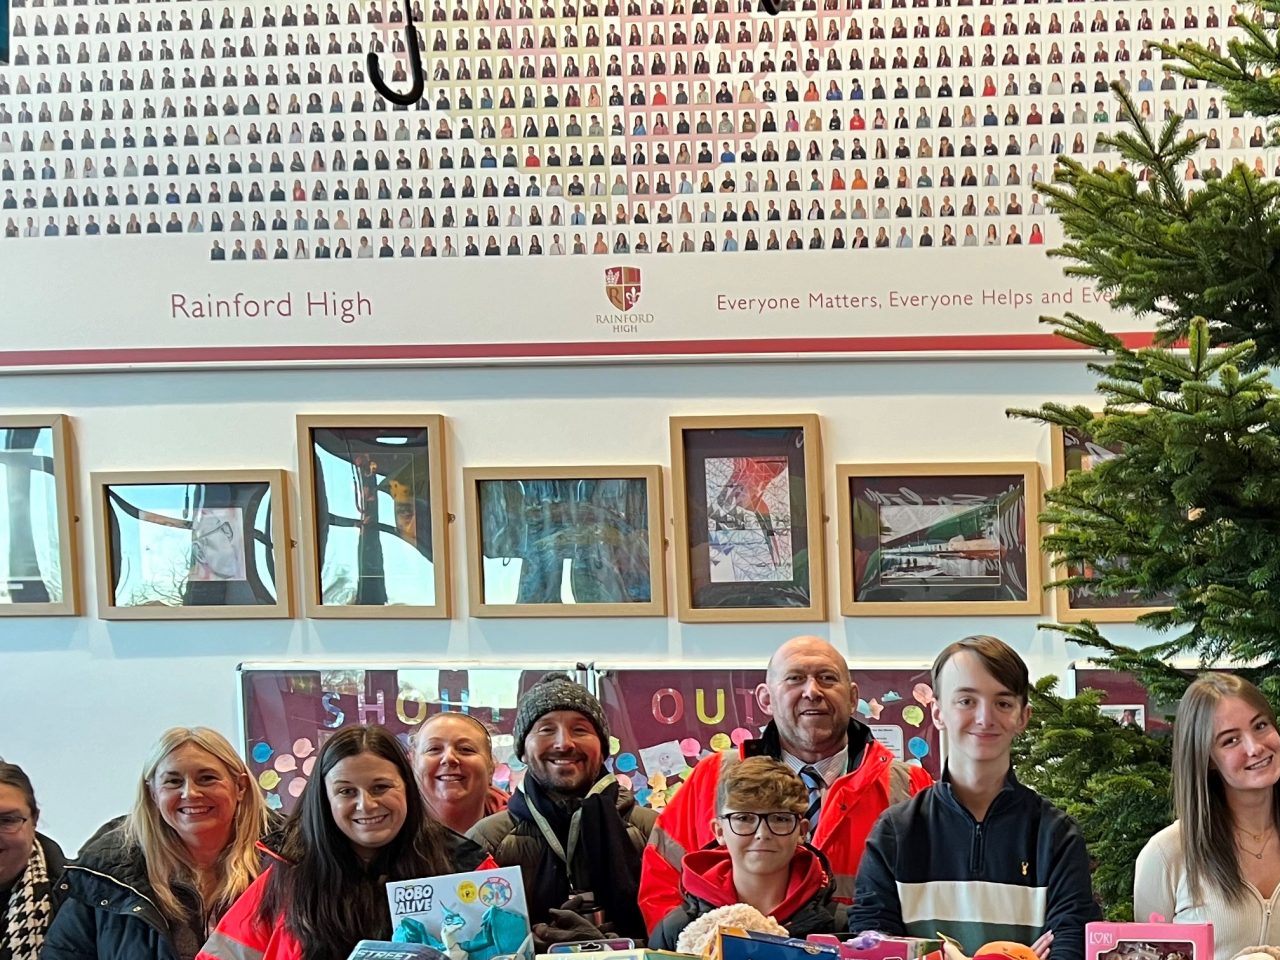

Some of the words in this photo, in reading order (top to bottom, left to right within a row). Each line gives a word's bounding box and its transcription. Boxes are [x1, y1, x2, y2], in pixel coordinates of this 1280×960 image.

[171, 292, 292, 318] Rainford
[307, 291, 372, 324] High
[717, 294, 801, 315] Everyone
[808, 291, 882, 309] Matters,
[889, 291, 974, 311] Everyone
[983, 288, 1033, 308] Helps
[1041, 287, 1073, 304] and
[1082, 287, 1120, 304] Ever
[596, 314, 655, 325] RAINFORD
[612, 324, 638, 334] HIGH
[395, 885, 434, 901] ROBO
[395, 899, 433, 915] ALIVE
